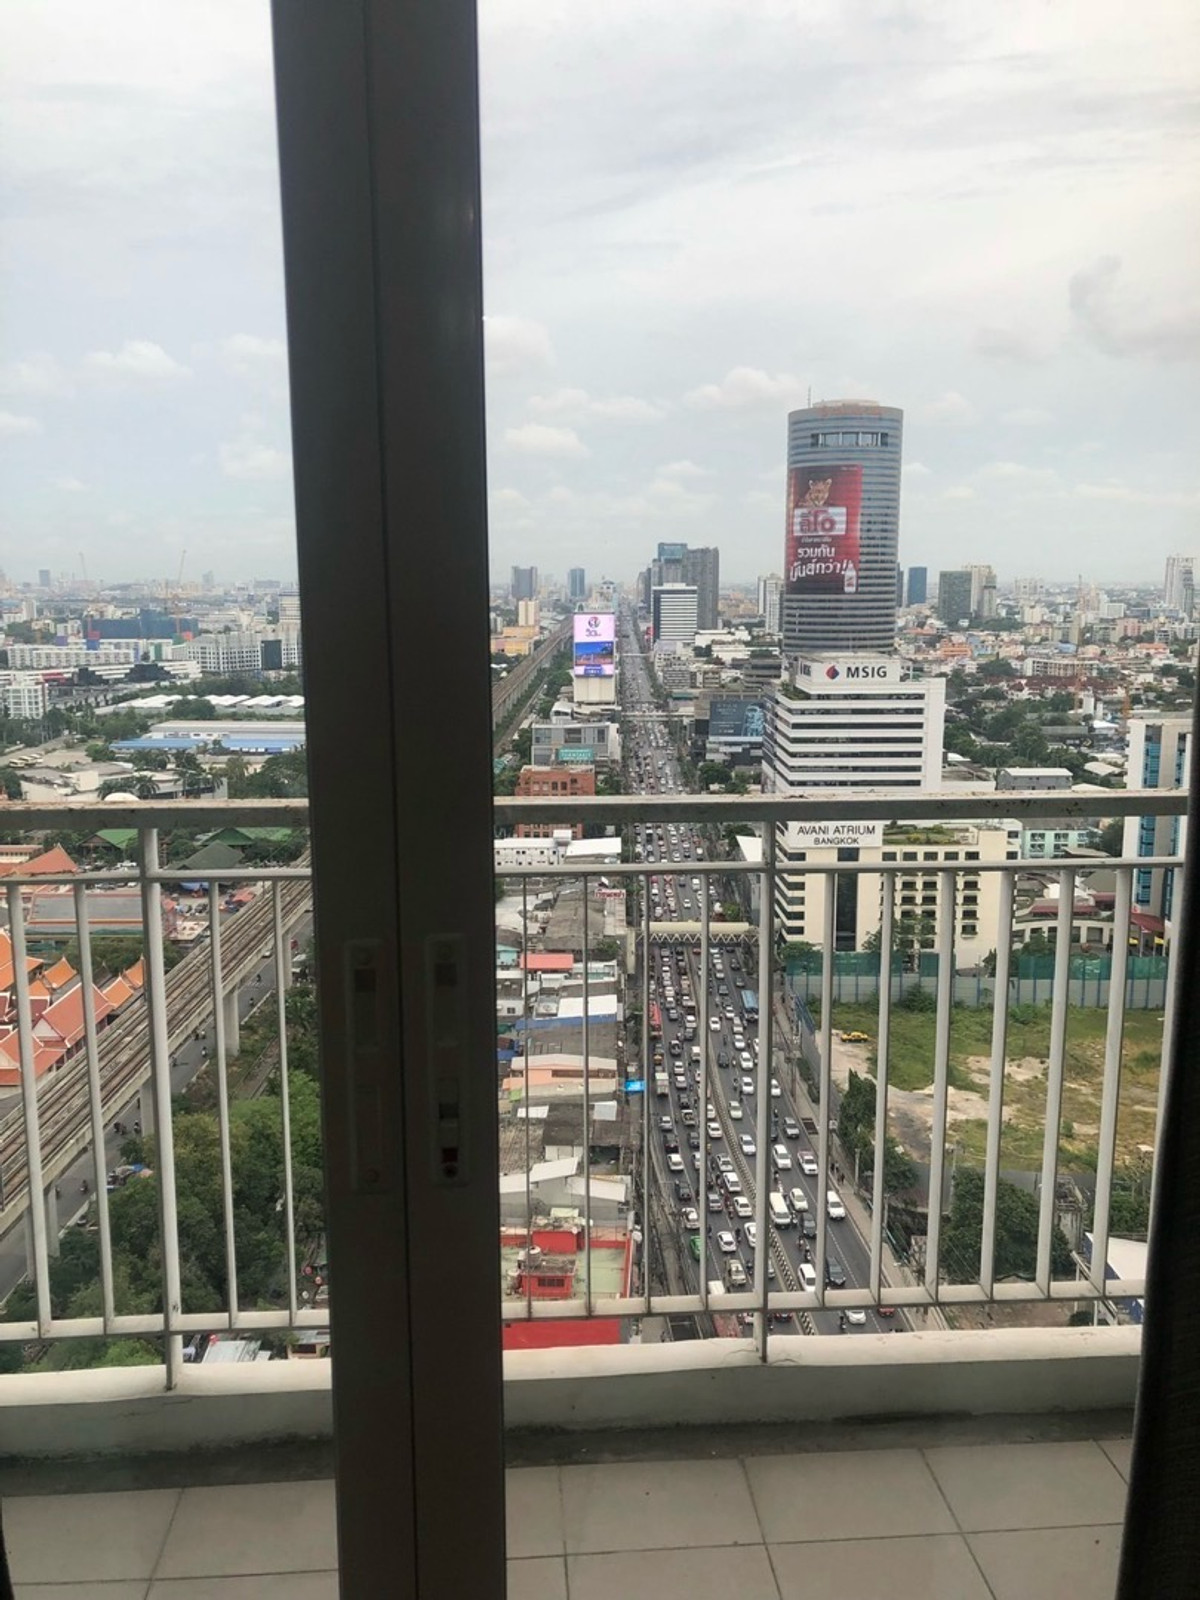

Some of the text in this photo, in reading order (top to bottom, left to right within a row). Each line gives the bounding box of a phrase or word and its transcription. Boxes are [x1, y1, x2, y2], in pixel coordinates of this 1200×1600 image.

[797, 544, 836, 558] รวมกัน
[846, 665, 887, 678] MSIG
[797, 825, 876, 835] AVANI ATRIUM
[813, 837, 860, 846] BANGKOK
